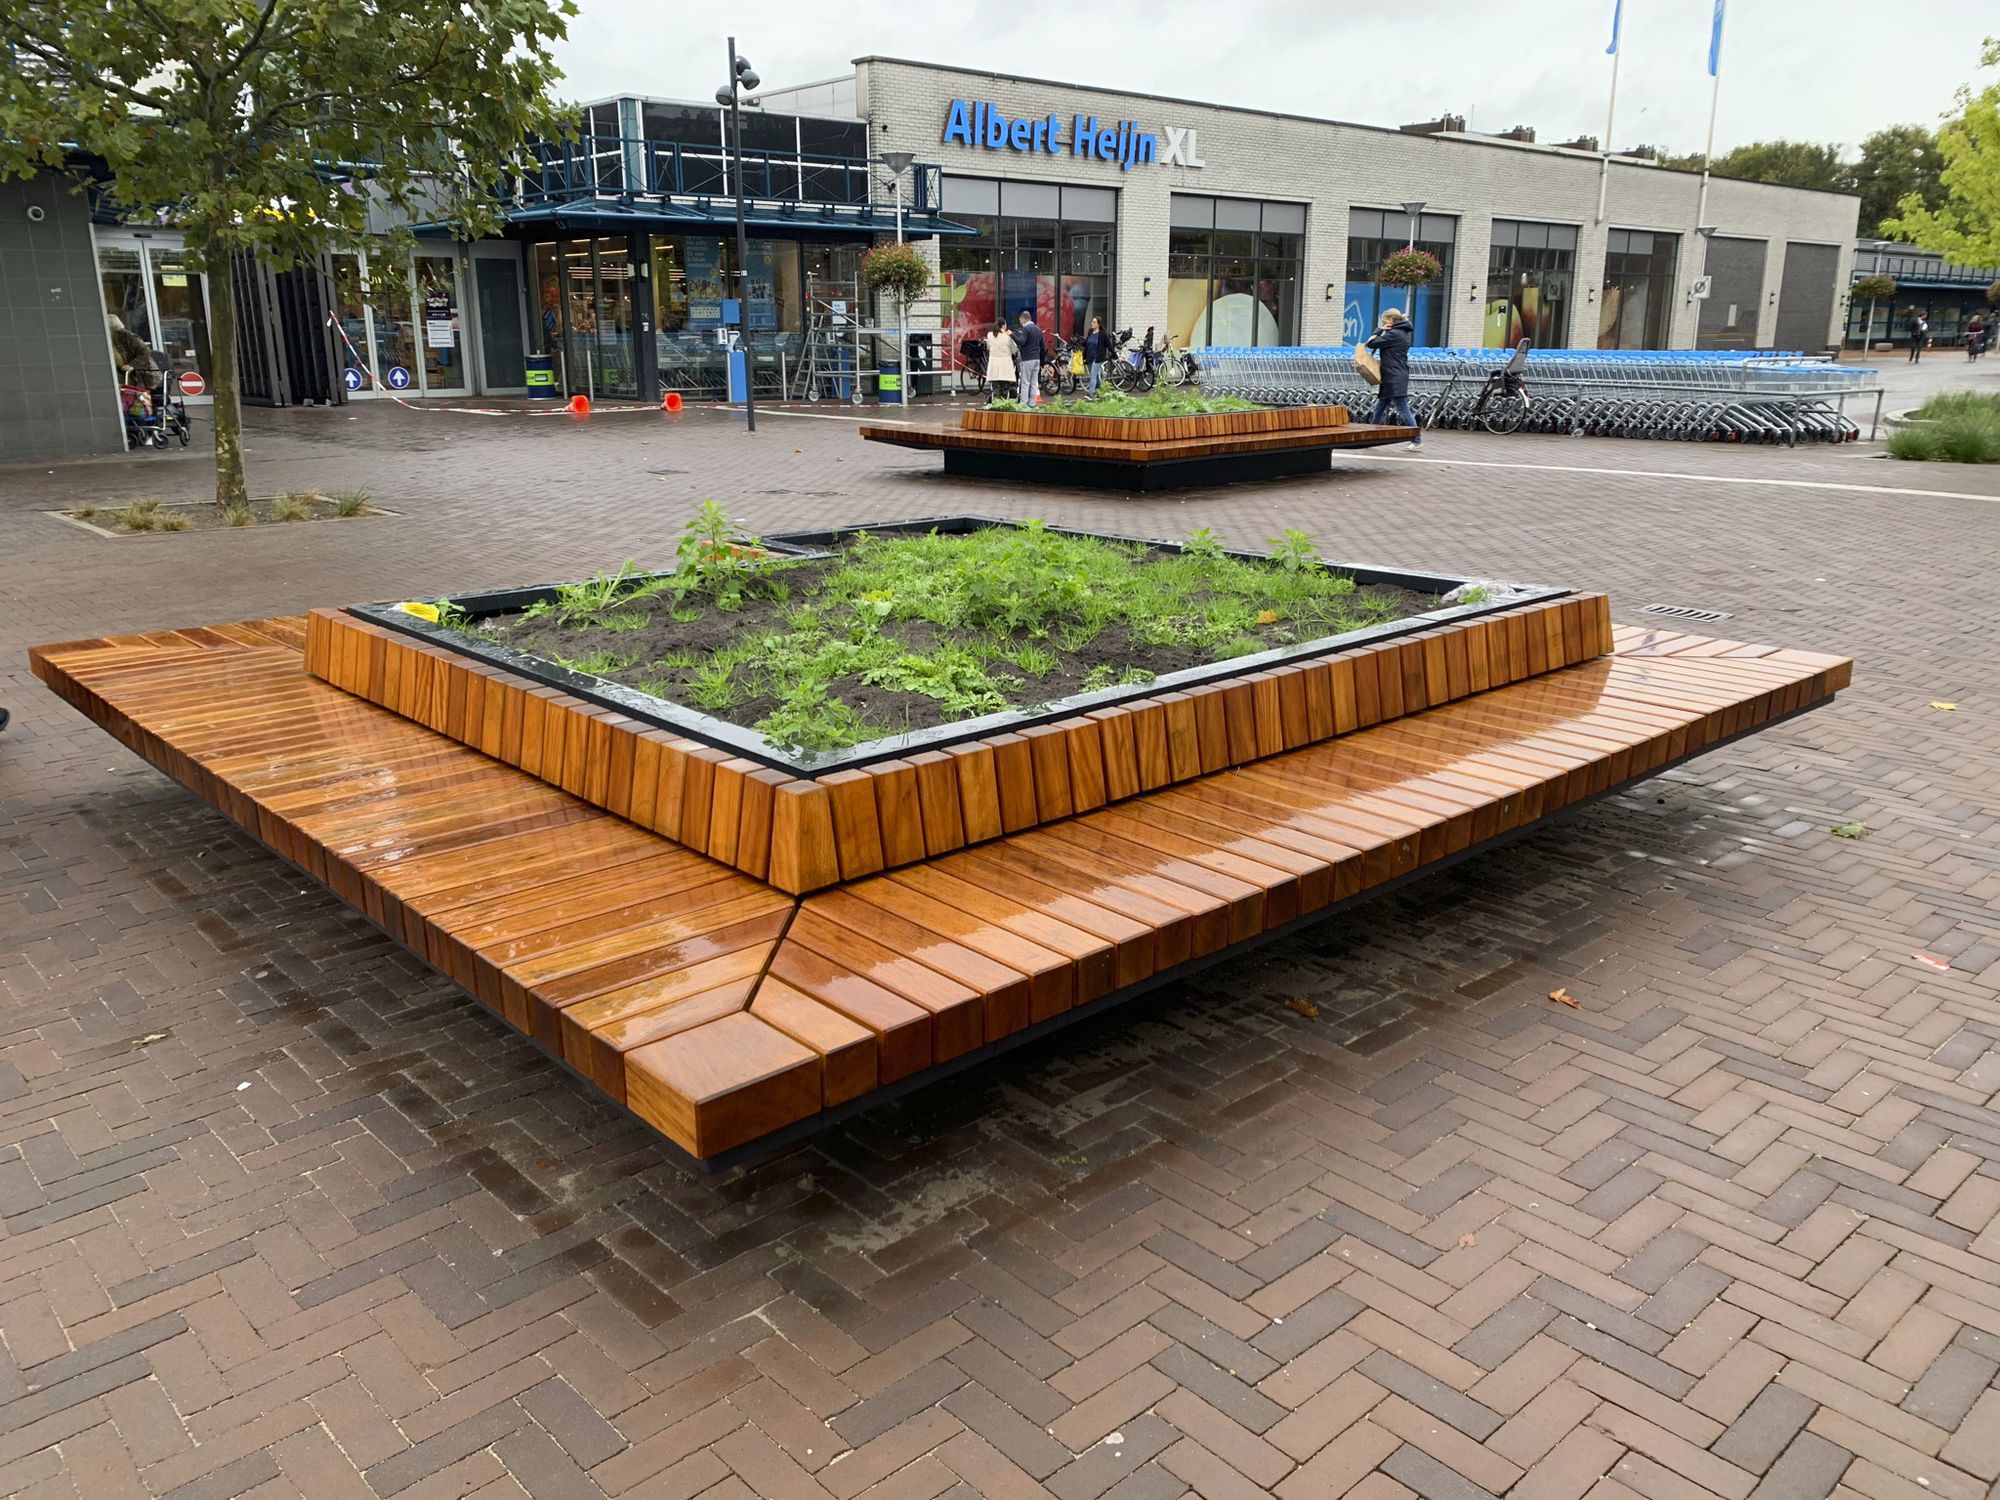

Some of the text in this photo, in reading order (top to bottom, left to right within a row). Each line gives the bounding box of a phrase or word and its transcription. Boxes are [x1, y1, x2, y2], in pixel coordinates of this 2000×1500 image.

[944, 98, 1206, 171] Albert Heijn XL
